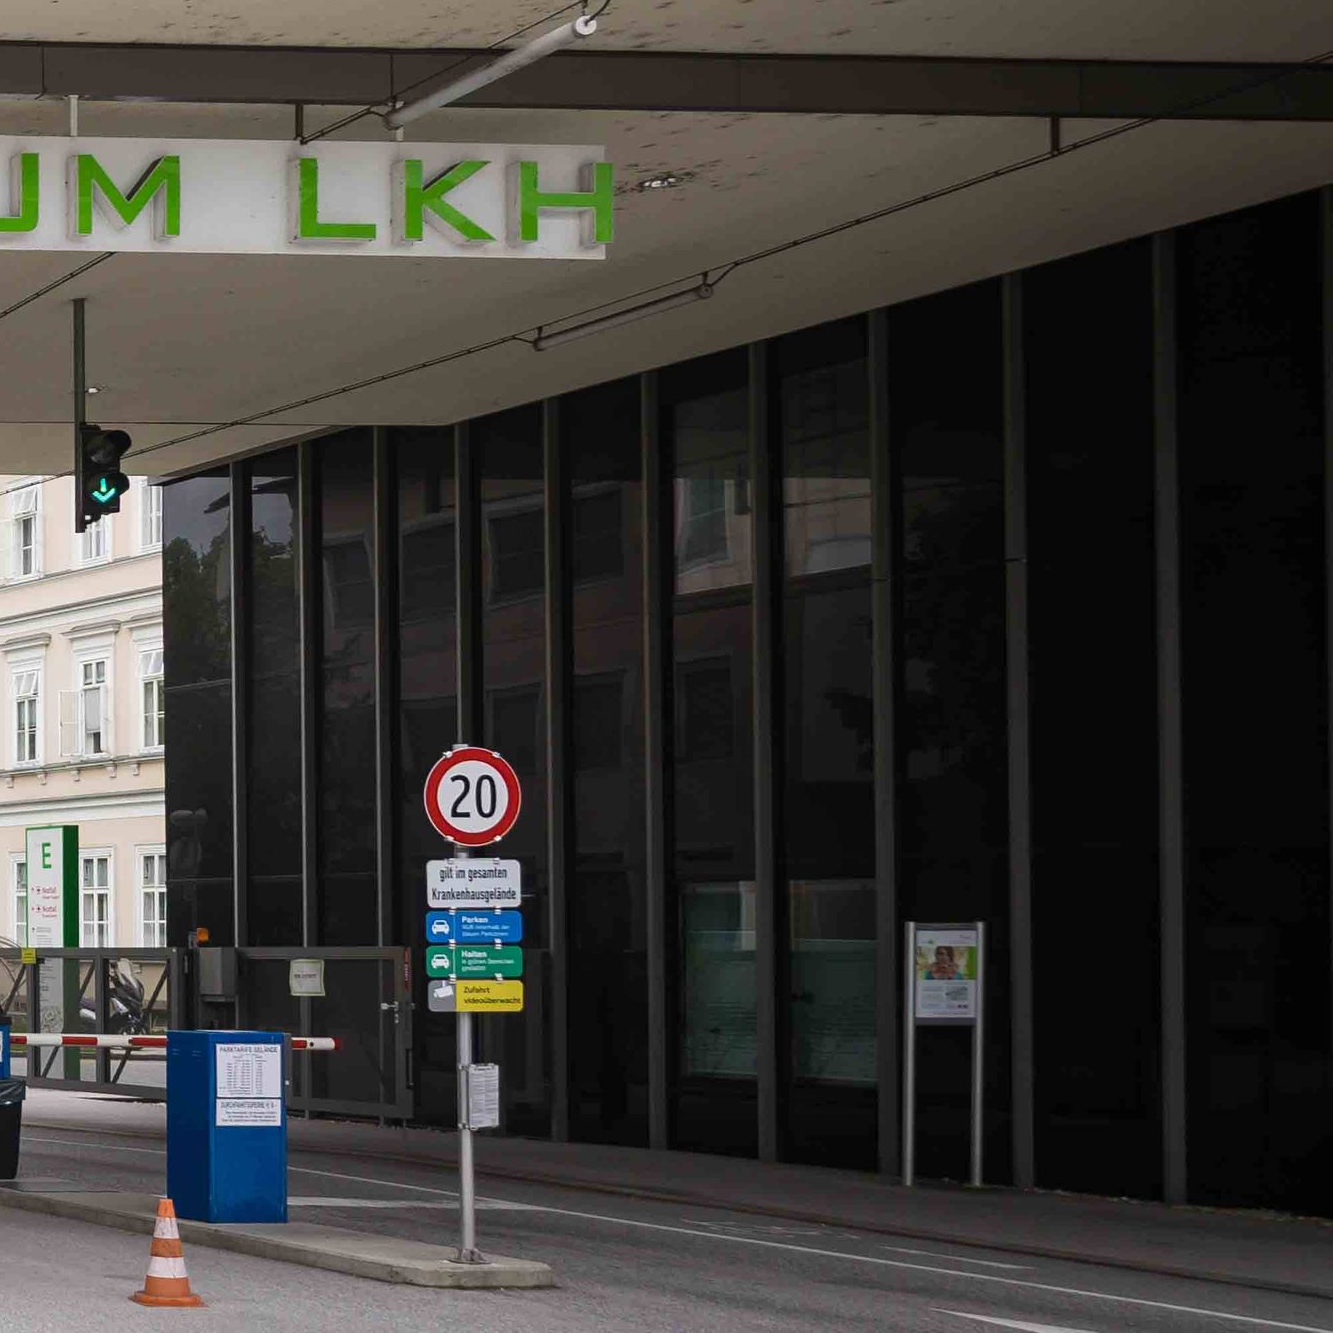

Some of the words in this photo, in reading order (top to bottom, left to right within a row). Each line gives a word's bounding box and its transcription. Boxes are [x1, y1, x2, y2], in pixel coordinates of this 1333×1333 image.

[295, 157, 615, 243] LKH
[450, 774, 498, 819] 20
[42, 843, 52, 869] E
[439, 867, 453, 882] gilt
[455, 866, 465, 879] im
[468, 868, 507, 882] gesamten
[431, 887, 517, 903] Krankenhausgelände
[461, 916, 489, 924] Parken
[464, 986, 490, 994] Zufahrt
